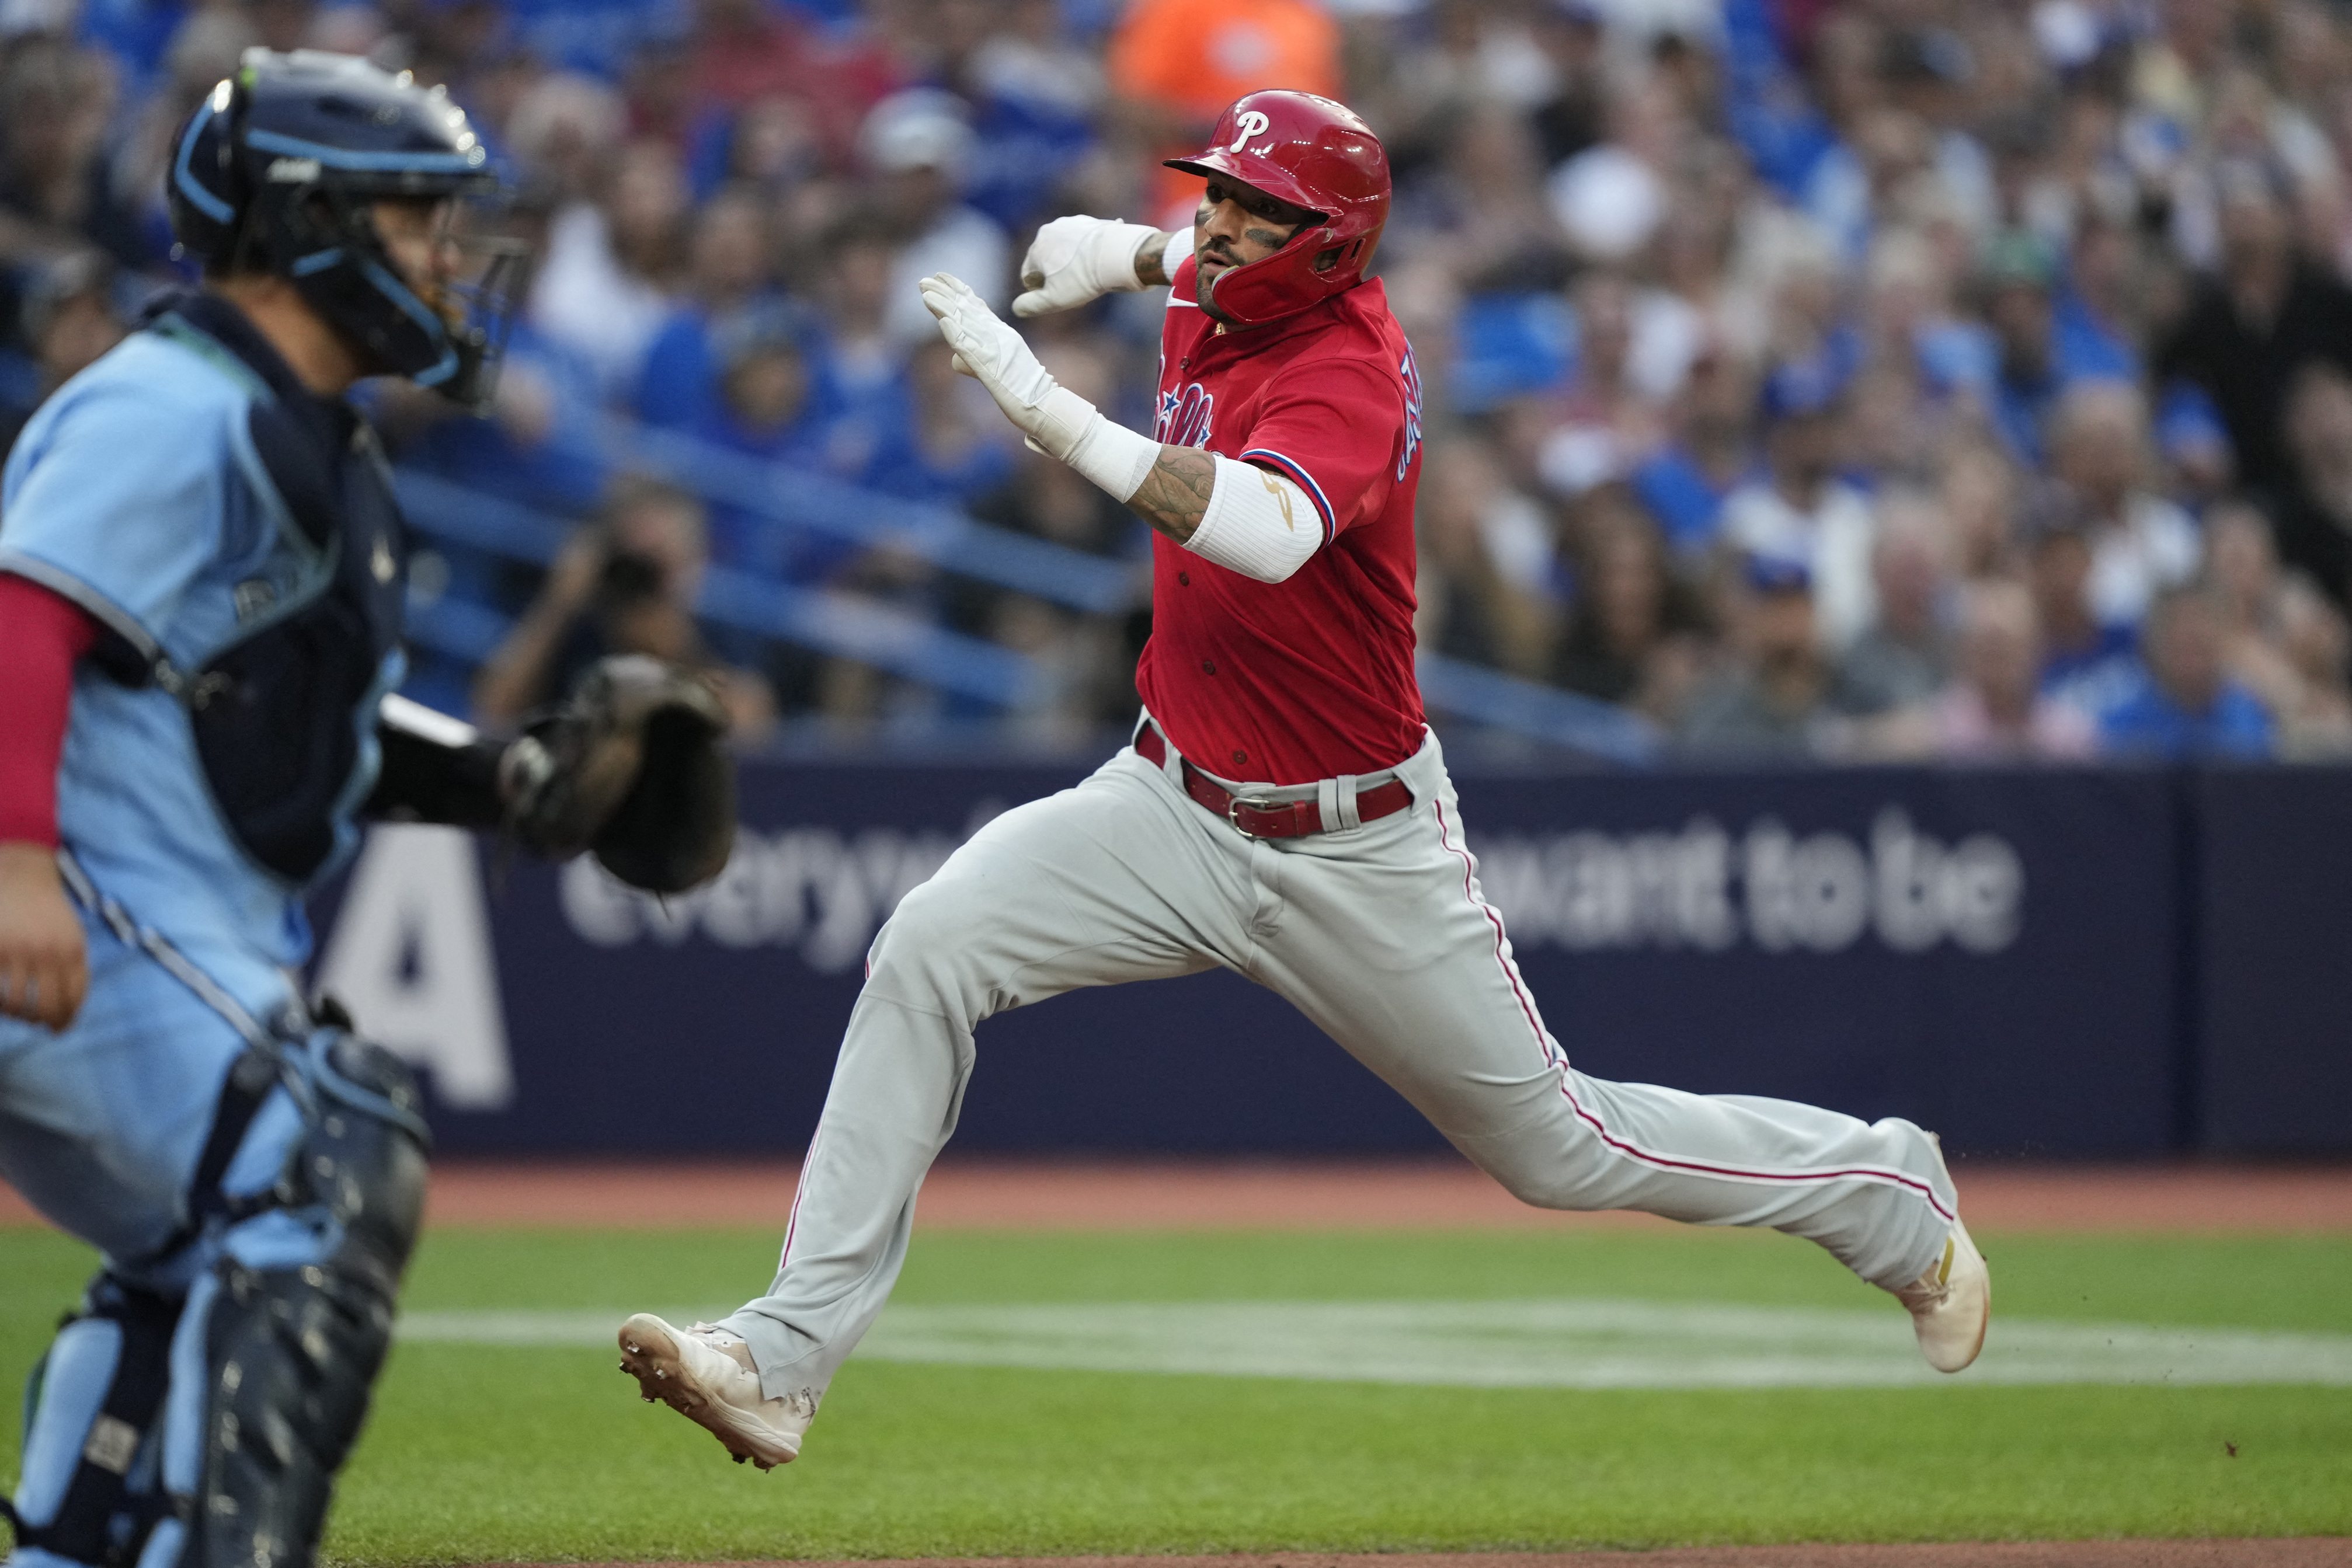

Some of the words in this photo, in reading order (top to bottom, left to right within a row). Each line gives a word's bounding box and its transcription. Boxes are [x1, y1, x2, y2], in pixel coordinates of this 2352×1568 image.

[1230, 110, 1269, 154] P
[1748, 814, 1867, 953] to
[1872, 803, 2025, 953] be
[314, 822, 514, 1106] A
